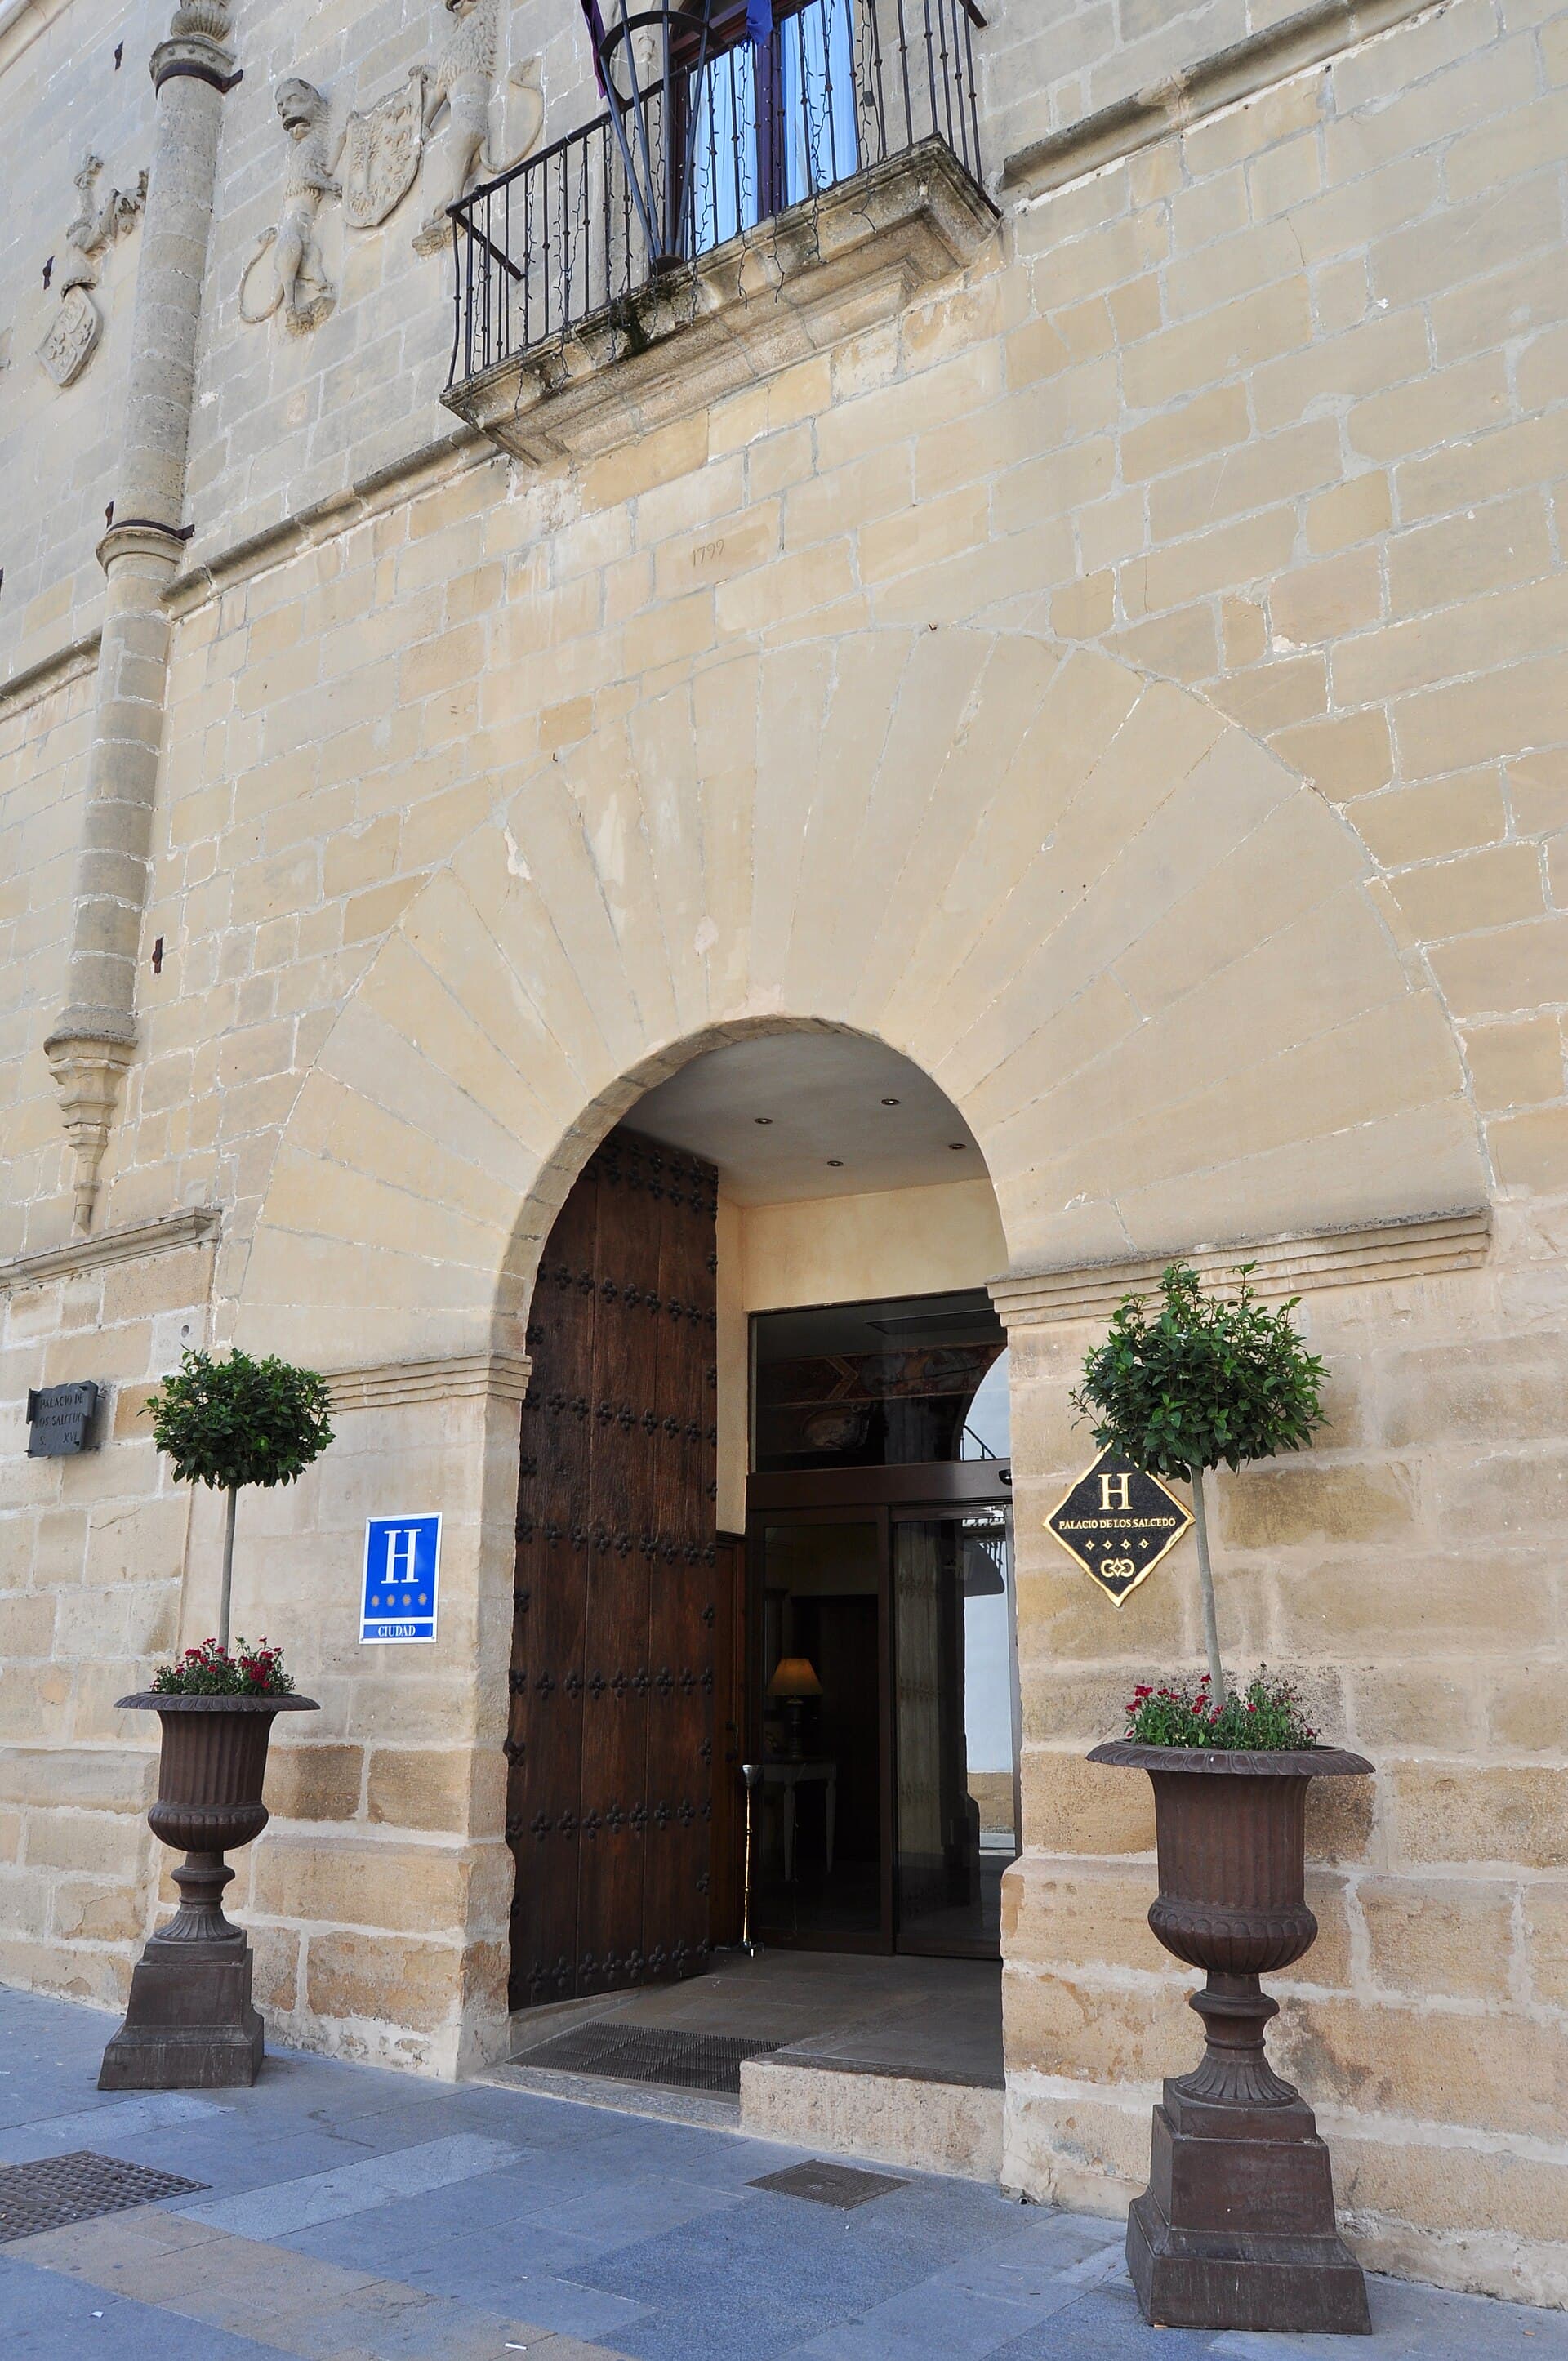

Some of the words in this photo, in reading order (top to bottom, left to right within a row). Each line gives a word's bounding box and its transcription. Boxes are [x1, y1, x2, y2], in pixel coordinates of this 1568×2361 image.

[40, 1395, 73, 1410] PALACIO
[74, 1393, 82, 1405] DE
[1098, 1472, 1134, 1510] H
[1058, 1521, 1098, 1530] PALACIO
[1099, 1519, 1112, 1528] DE
[1114, 1519, 1131, 1528] LOS
[1133, 1518, 1176, 1527] SALCEDO
[381, 1528, 422, 1584] H
[377, 1624, 416, 1637] CIUDAD
